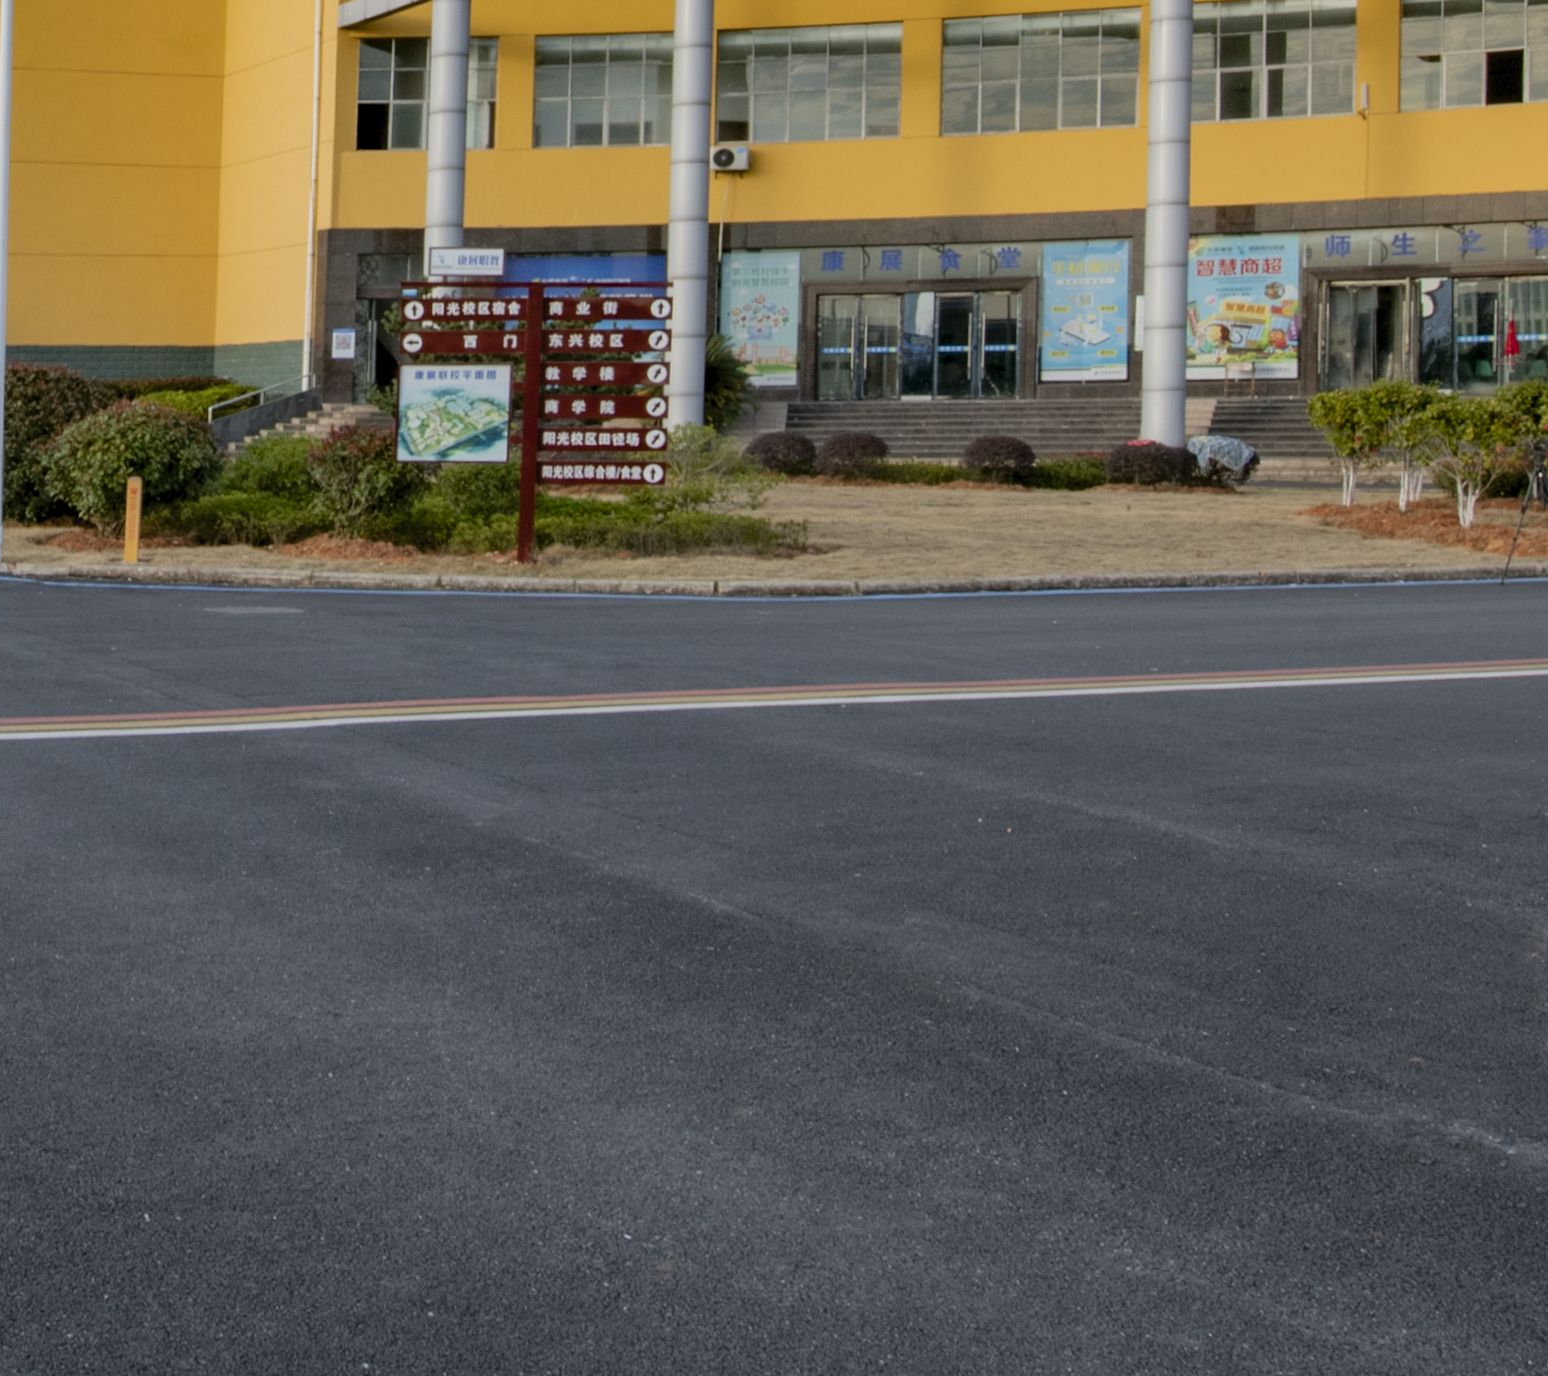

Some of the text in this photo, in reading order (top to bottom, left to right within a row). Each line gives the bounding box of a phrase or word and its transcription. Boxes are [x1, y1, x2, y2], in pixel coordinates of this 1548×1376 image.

[821, 246, 1021, 272] 康展食堂
[1196, 257, 1282, 276] 智慧商超
[431, 301, 521, 317] 阳光校区宿舍
[549, 301, 618, 316] 商业街
[463, 334, 518, 349] 西门
[549, 334, 624, 349] 东兴校区
[545, 366, 615, 381] 教学楼
[545, 400, 615, 415] 商学院
[542, 431, 640, 447] 阳光校区田径场
[541, 465, 642, 480] 阳光校区综合楼/食堂
